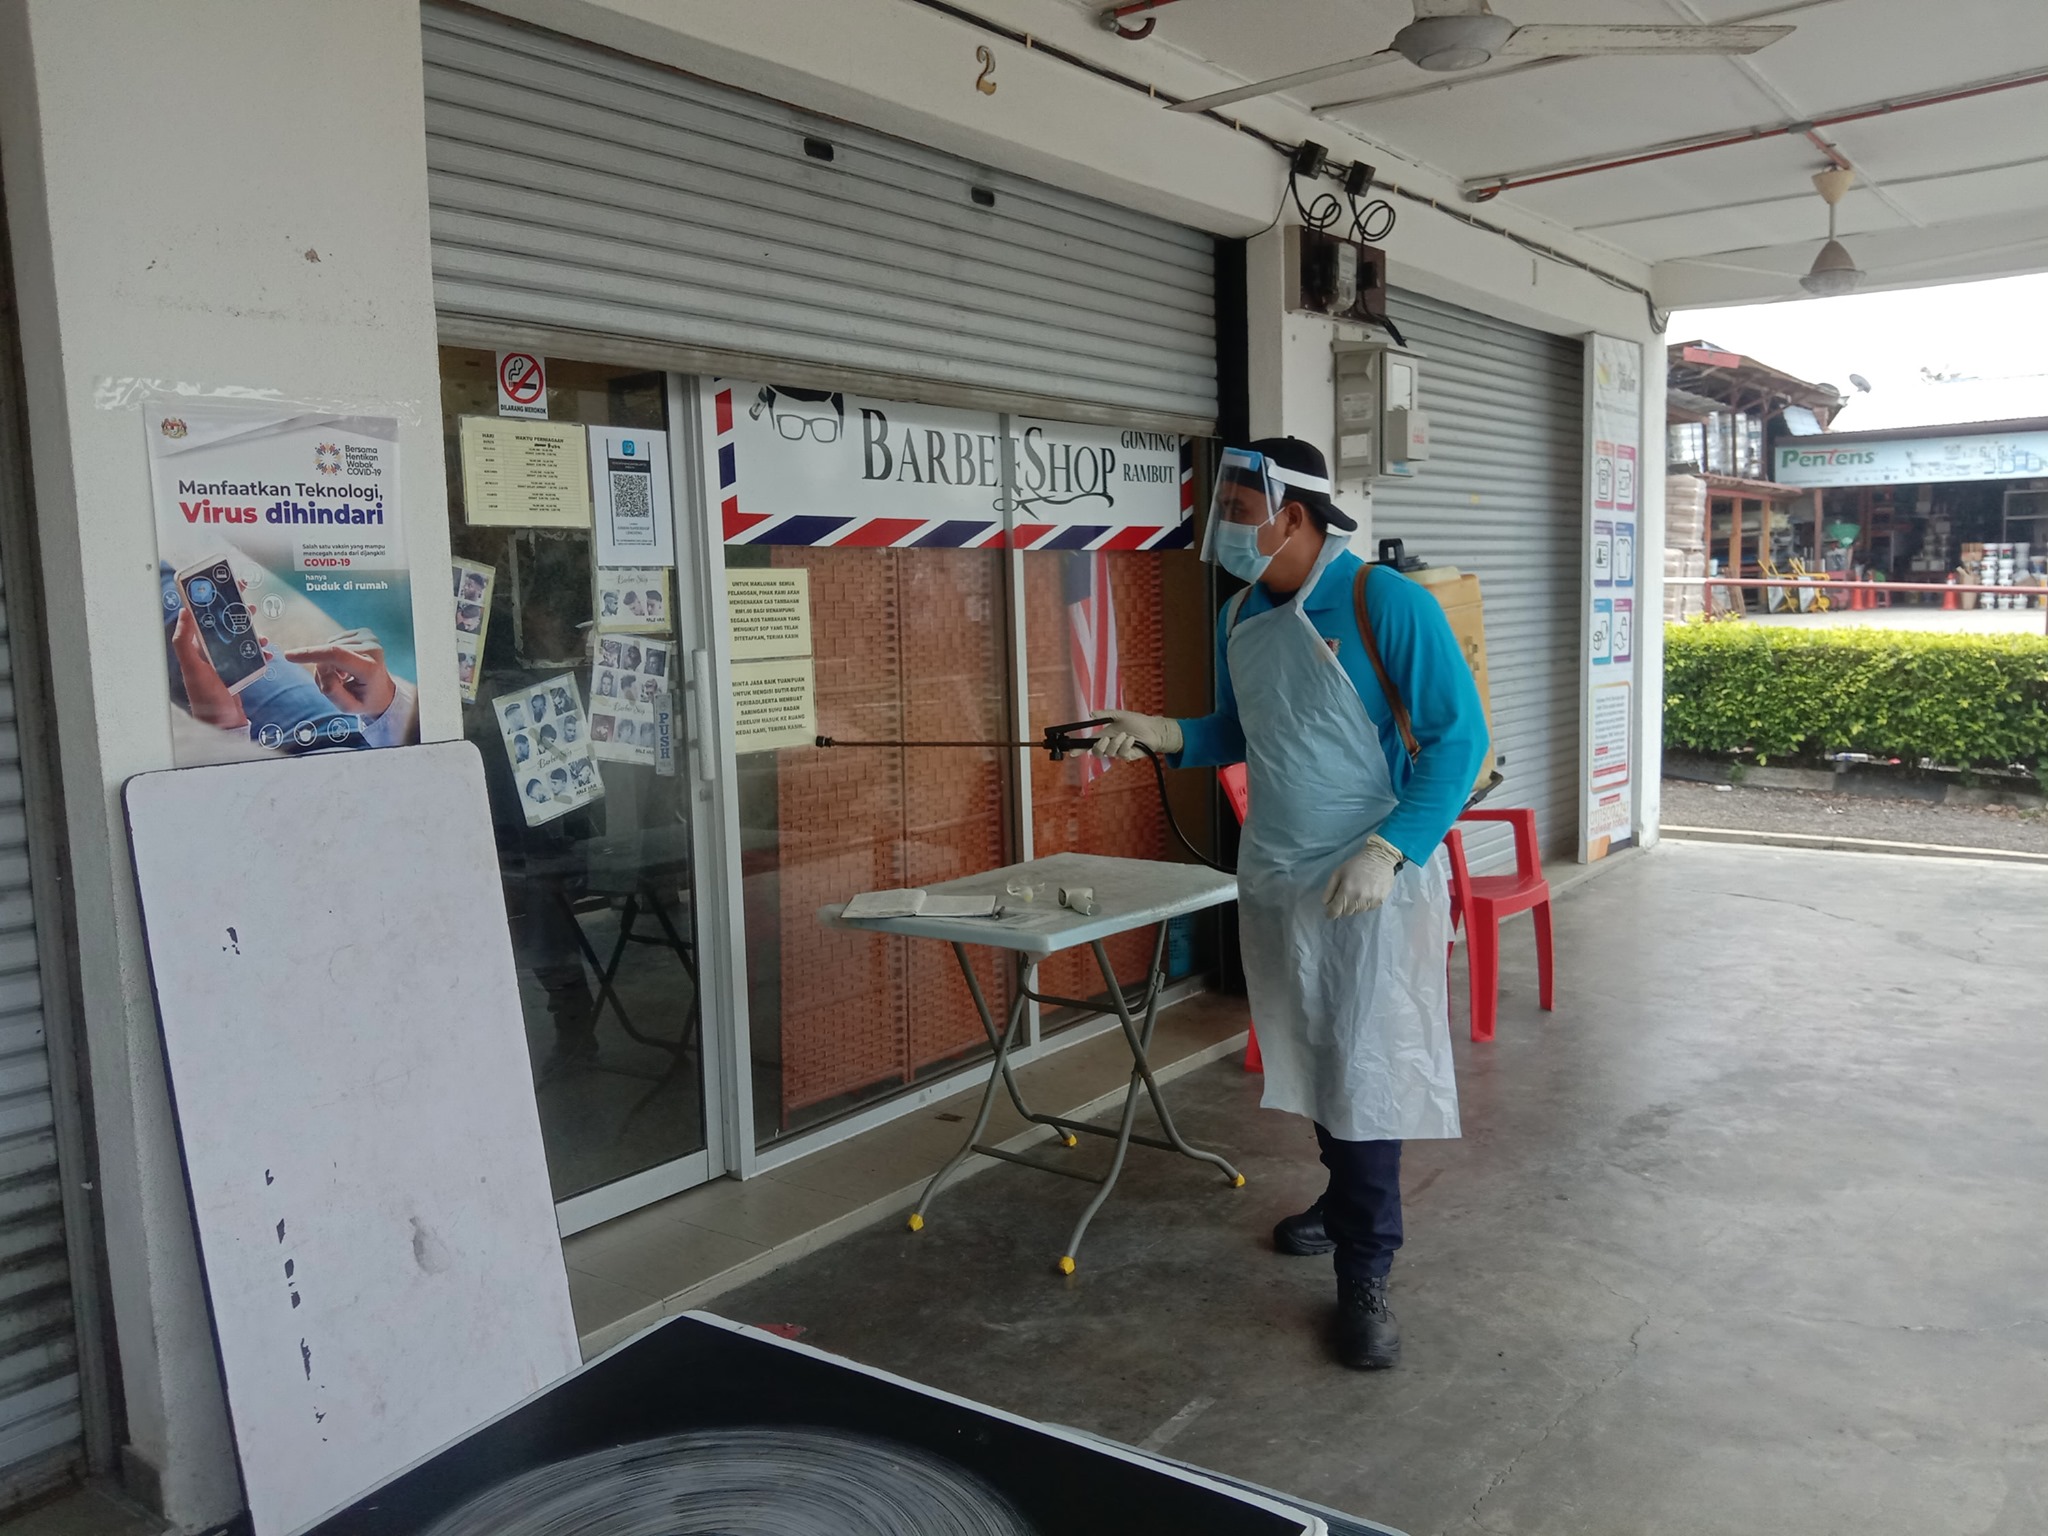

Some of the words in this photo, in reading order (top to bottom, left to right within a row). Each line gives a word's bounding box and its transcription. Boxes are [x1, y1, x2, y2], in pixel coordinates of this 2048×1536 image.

[976, 45, 996, 95] 2
[501, 404, 523, 412] DILARANG
[345, 445, 378, 454] Bersama
[1121, 430, 1175, 452] GUNTING
[345, 453, 378, 461] Hentikan
[1123, 463, 1175, 484] RAMBUT
[179, 480, 290, 497] Manfaatkan
[295, 483, 383, 501] Teknologi,
[179, 499, 258, 523] Virus
[265, 501, 384, 524] dihindari
[306, 582, 340, 591] Duduk
[343, 581, 352, 590] di
[355, 581, 388, 590] rumah
[659, 712, 670, 759] PUSH
